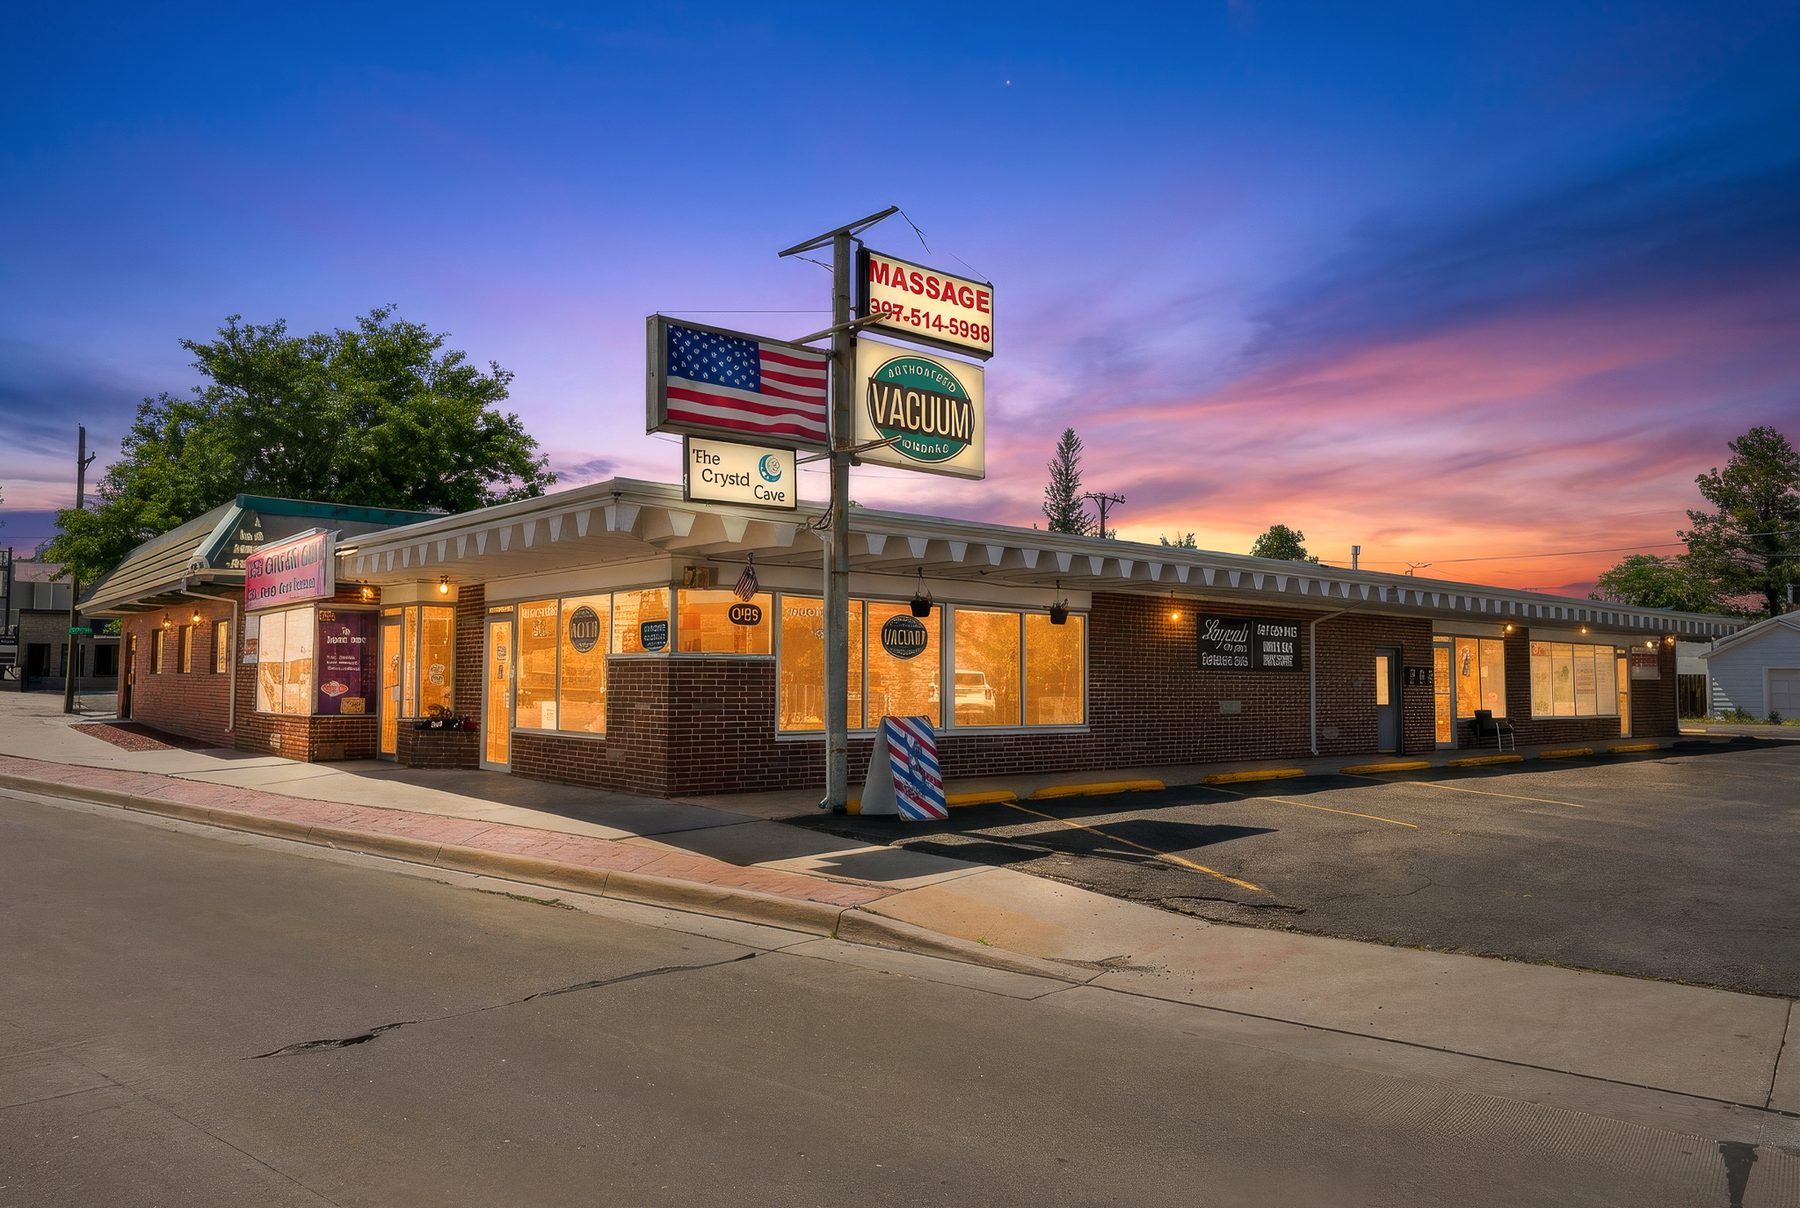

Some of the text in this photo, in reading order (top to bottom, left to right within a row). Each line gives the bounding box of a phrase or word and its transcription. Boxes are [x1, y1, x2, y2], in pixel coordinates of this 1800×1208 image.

[869, 259, 990, 314] MASSAGE
[872, 383, 969, 440] VACUUM
[754, 485, 785, 502] Cave
